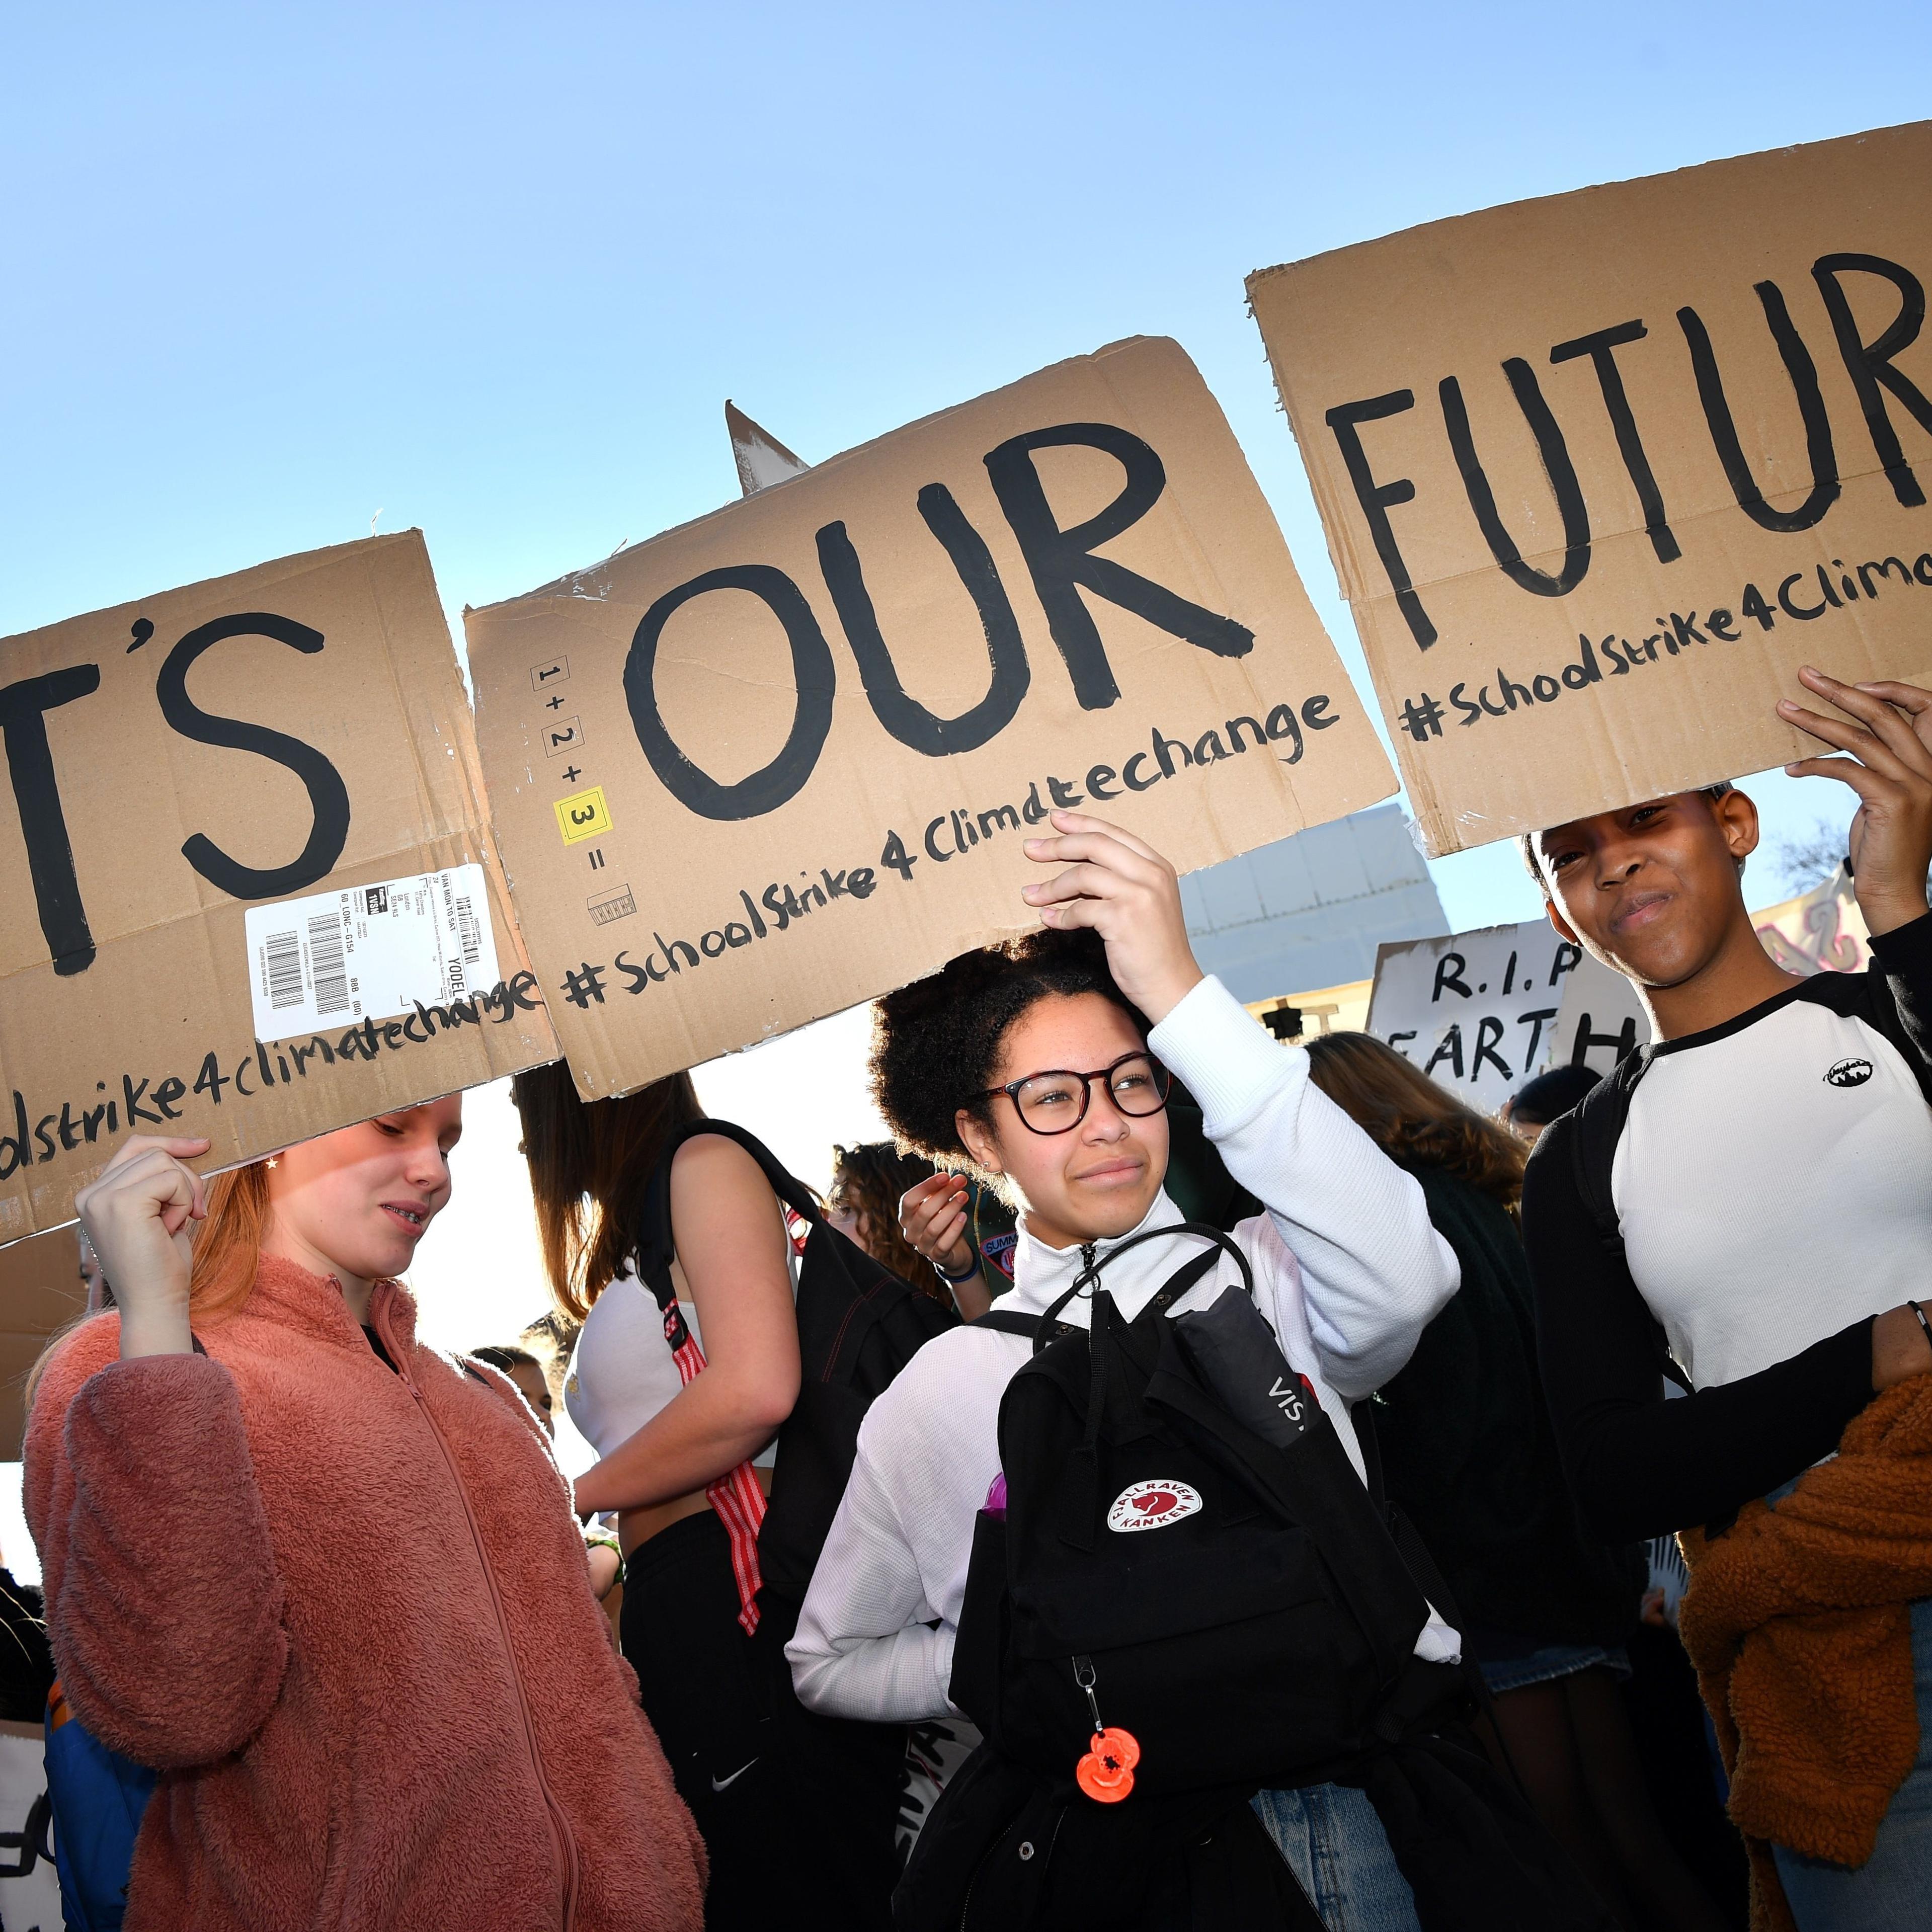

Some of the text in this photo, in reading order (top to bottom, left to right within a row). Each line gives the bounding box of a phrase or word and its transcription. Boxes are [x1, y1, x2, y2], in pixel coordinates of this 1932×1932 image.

[1325, 252, 1932, 652] FUTUR
[623, 422, 1256, 821] OUR
[539, 666, 561, 681] 1
[551, 728, 574, 747] 2
[571, 804, 595, 826] 3
[369, 895, 379, 914] 1VSN
[447, 906, 453, 916] TO
[351, 978, 359, 992] 88B
[448, 957, 465, 997] YODEL
[352, 1001, 361, 1015] (00)
[1268, 1376, 1304, 1431] VIS
